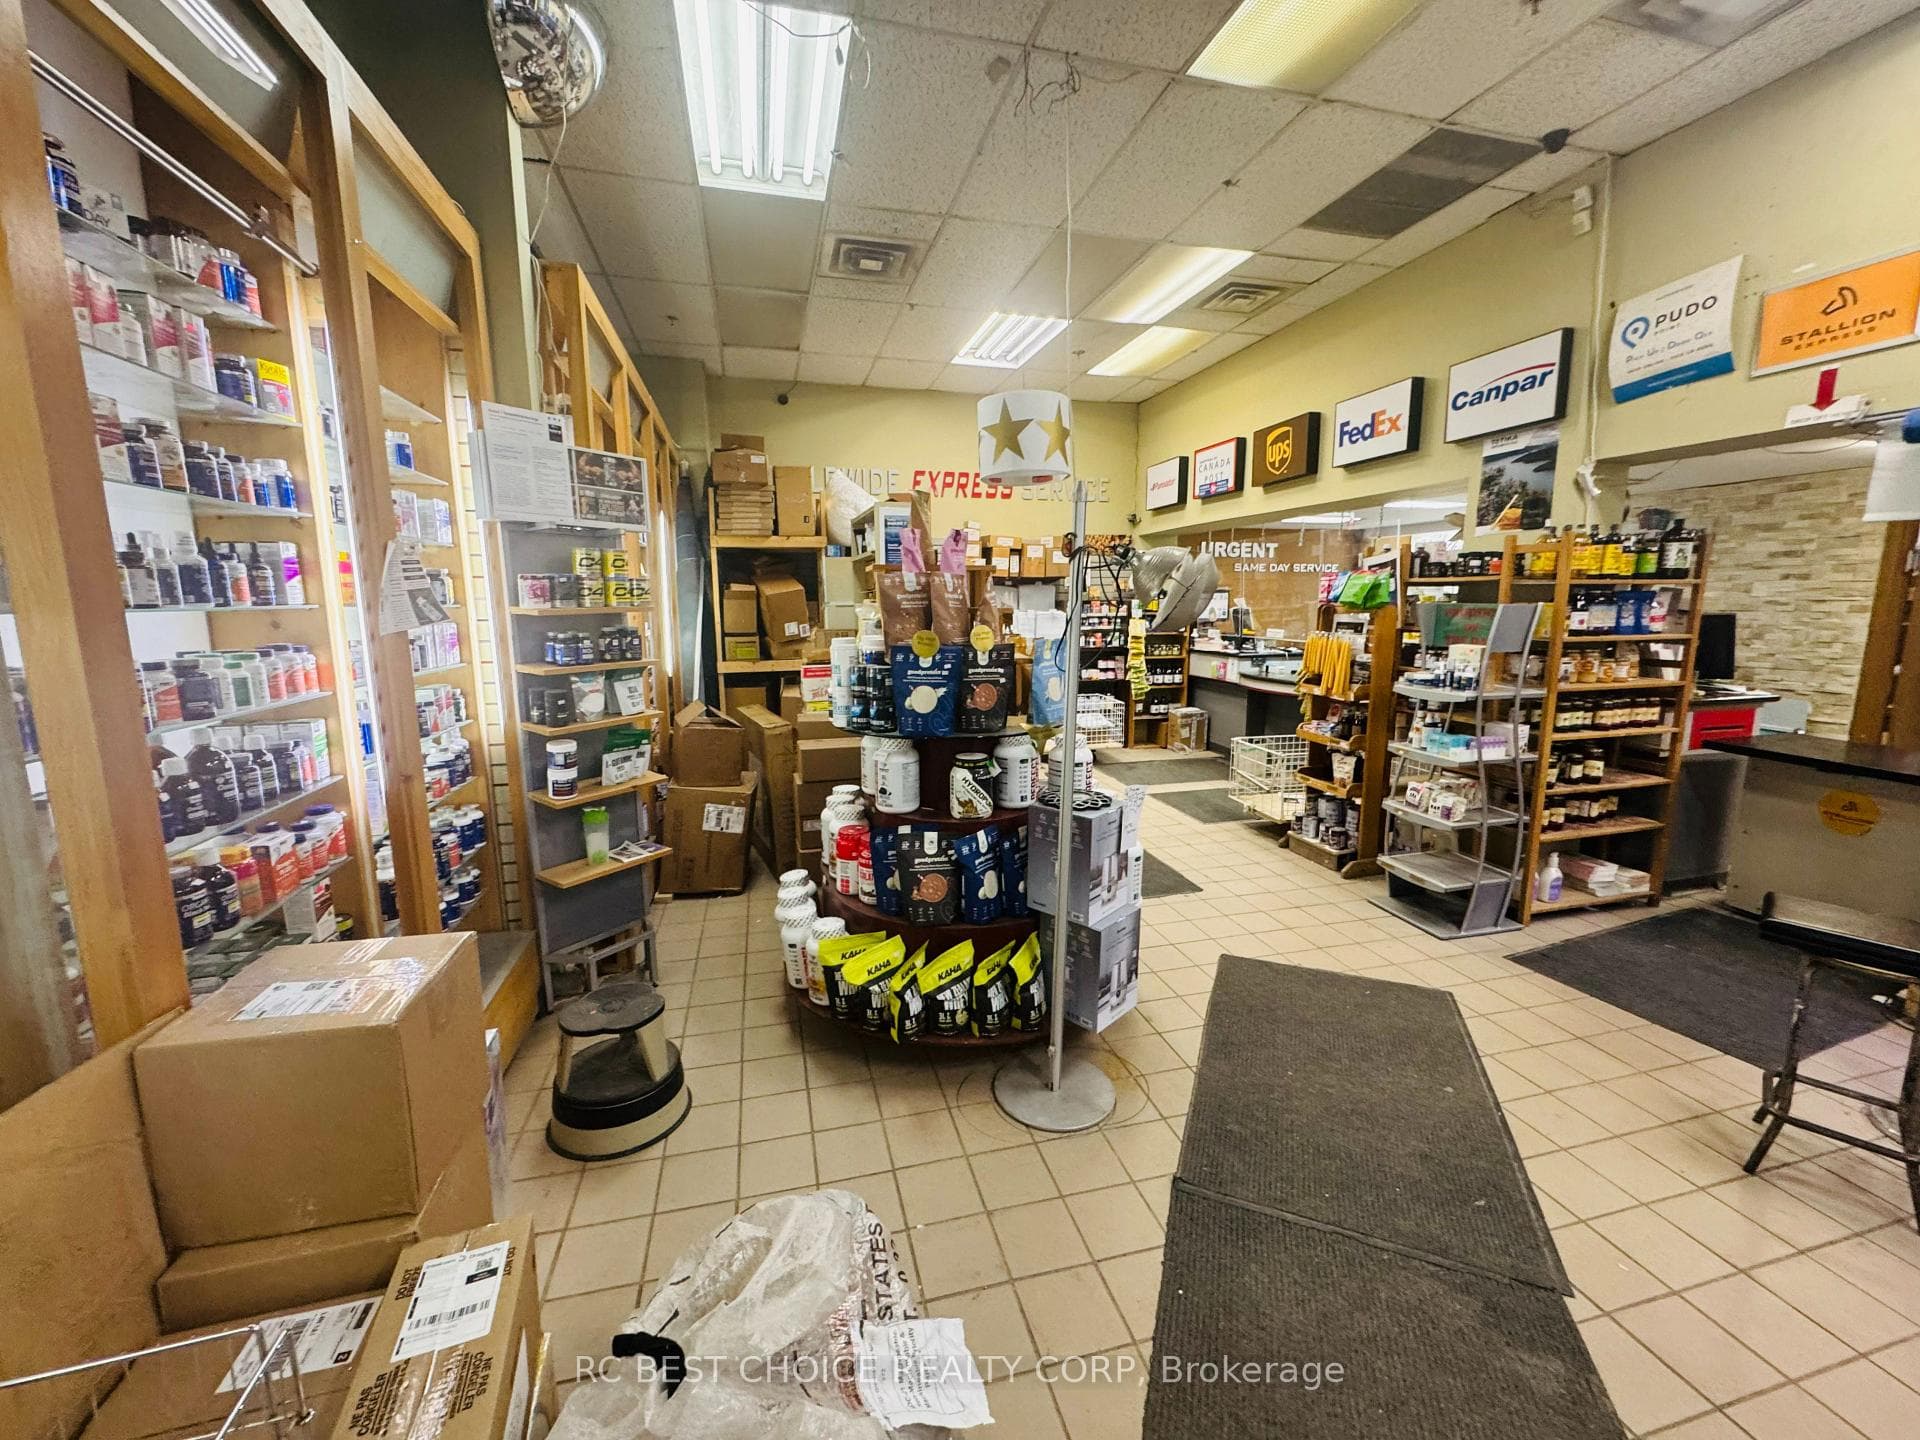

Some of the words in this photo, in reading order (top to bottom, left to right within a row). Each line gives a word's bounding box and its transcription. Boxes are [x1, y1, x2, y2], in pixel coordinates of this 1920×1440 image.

[1655, 296, 1718, 328] PUDO
[1780, 308, 1896, 346] STALLION
[1451, 369, 1554, 412] Canpar
[1338, 409, 1404, 448] FedEx
[1198, 456, 1232, 473] CANADA
[1268, 439, 1290, 468] ups
[912, 470, 1013, 499] EXPRESS
[1200, 541, 1279, 559] URGENT
[1234, 563, 1267, 573] SAME
[1269, 563, 1290, 573] DAY
[1293, 563, 1339, 573] SERVICE
[867, 958, 891, 976] KAHA
[937, 963, 962, 981] KAHA
[868, 1221, 893, 1321] STATES
[481, 1356, 494, 1373] NE
[461, 1351, 485, 1411] CONGELER
[476, 1374, 489, 1397] PAS
[355, 1385, 371, 1411] PAS
[356, 1372, 388, 1437] CONGELER
[348, 1413, 363, 1430] NE
